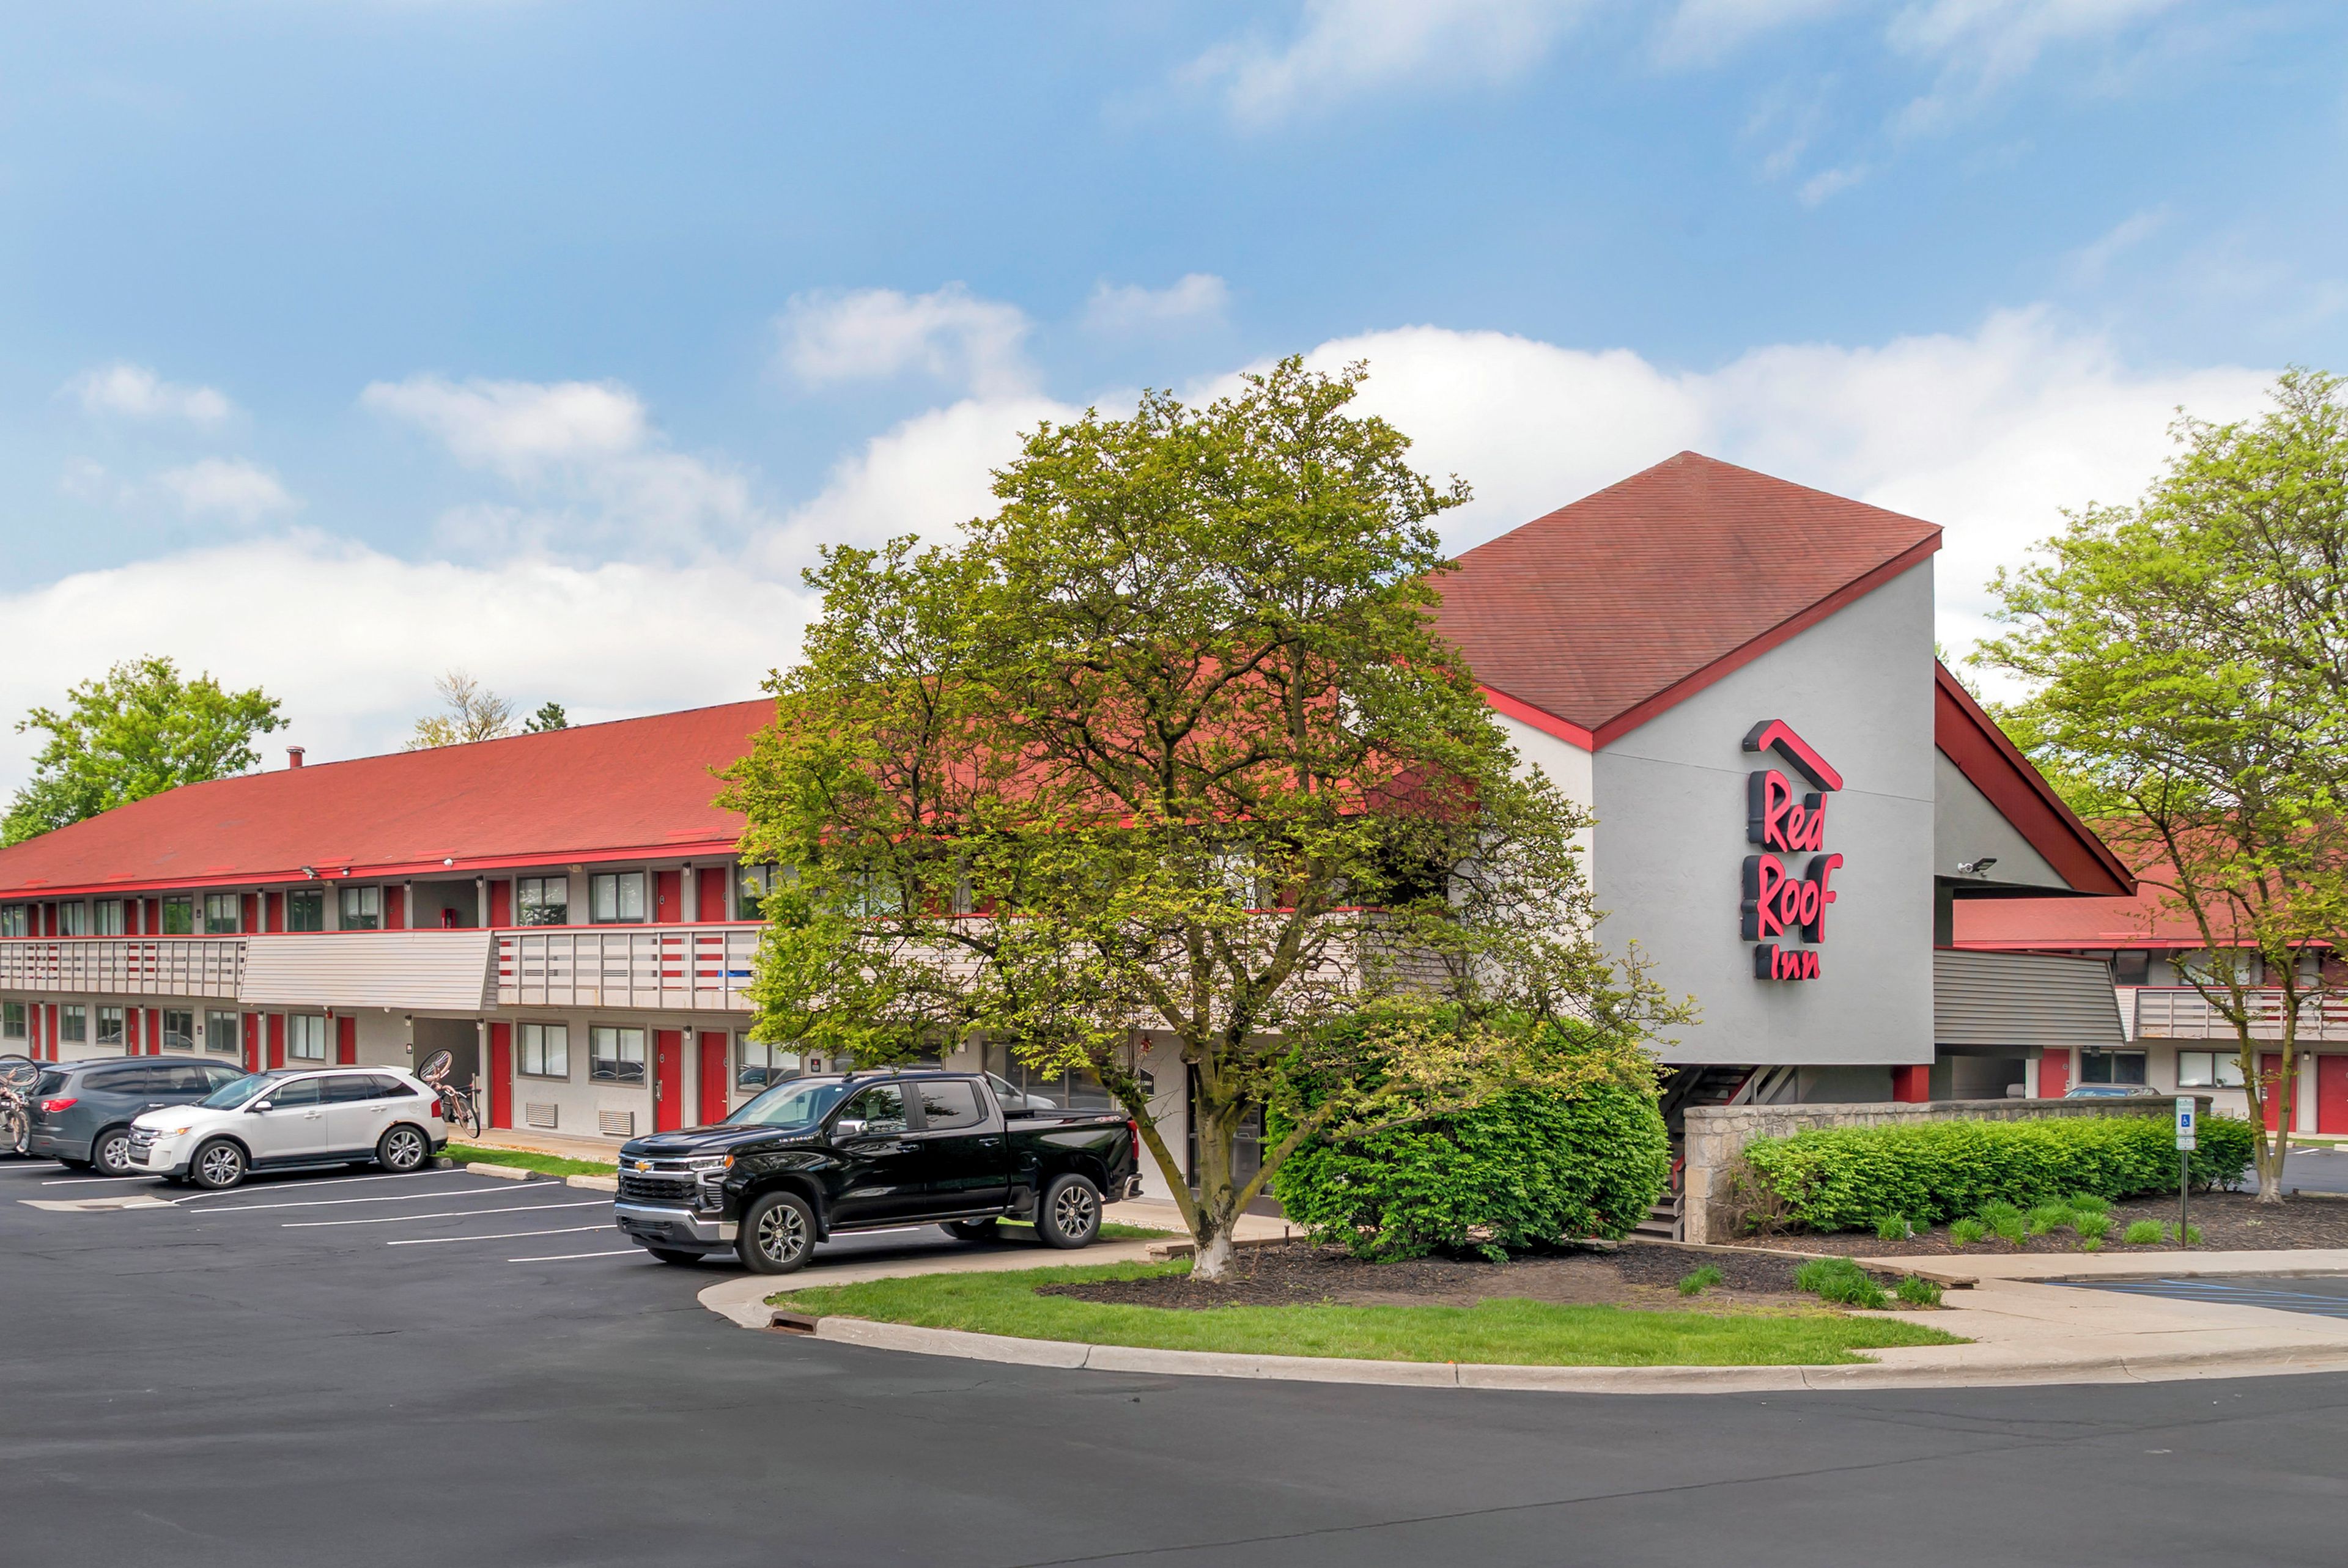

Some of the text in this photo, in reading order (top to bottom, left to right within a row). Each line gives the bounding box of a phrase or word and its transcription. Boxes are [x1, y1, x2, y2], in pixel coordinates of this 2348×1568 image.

[1764, 769, 1828, 852] Red
[1757, 853, 1844, 943] Roof
[1771, 943, 1820, 981] Inn
